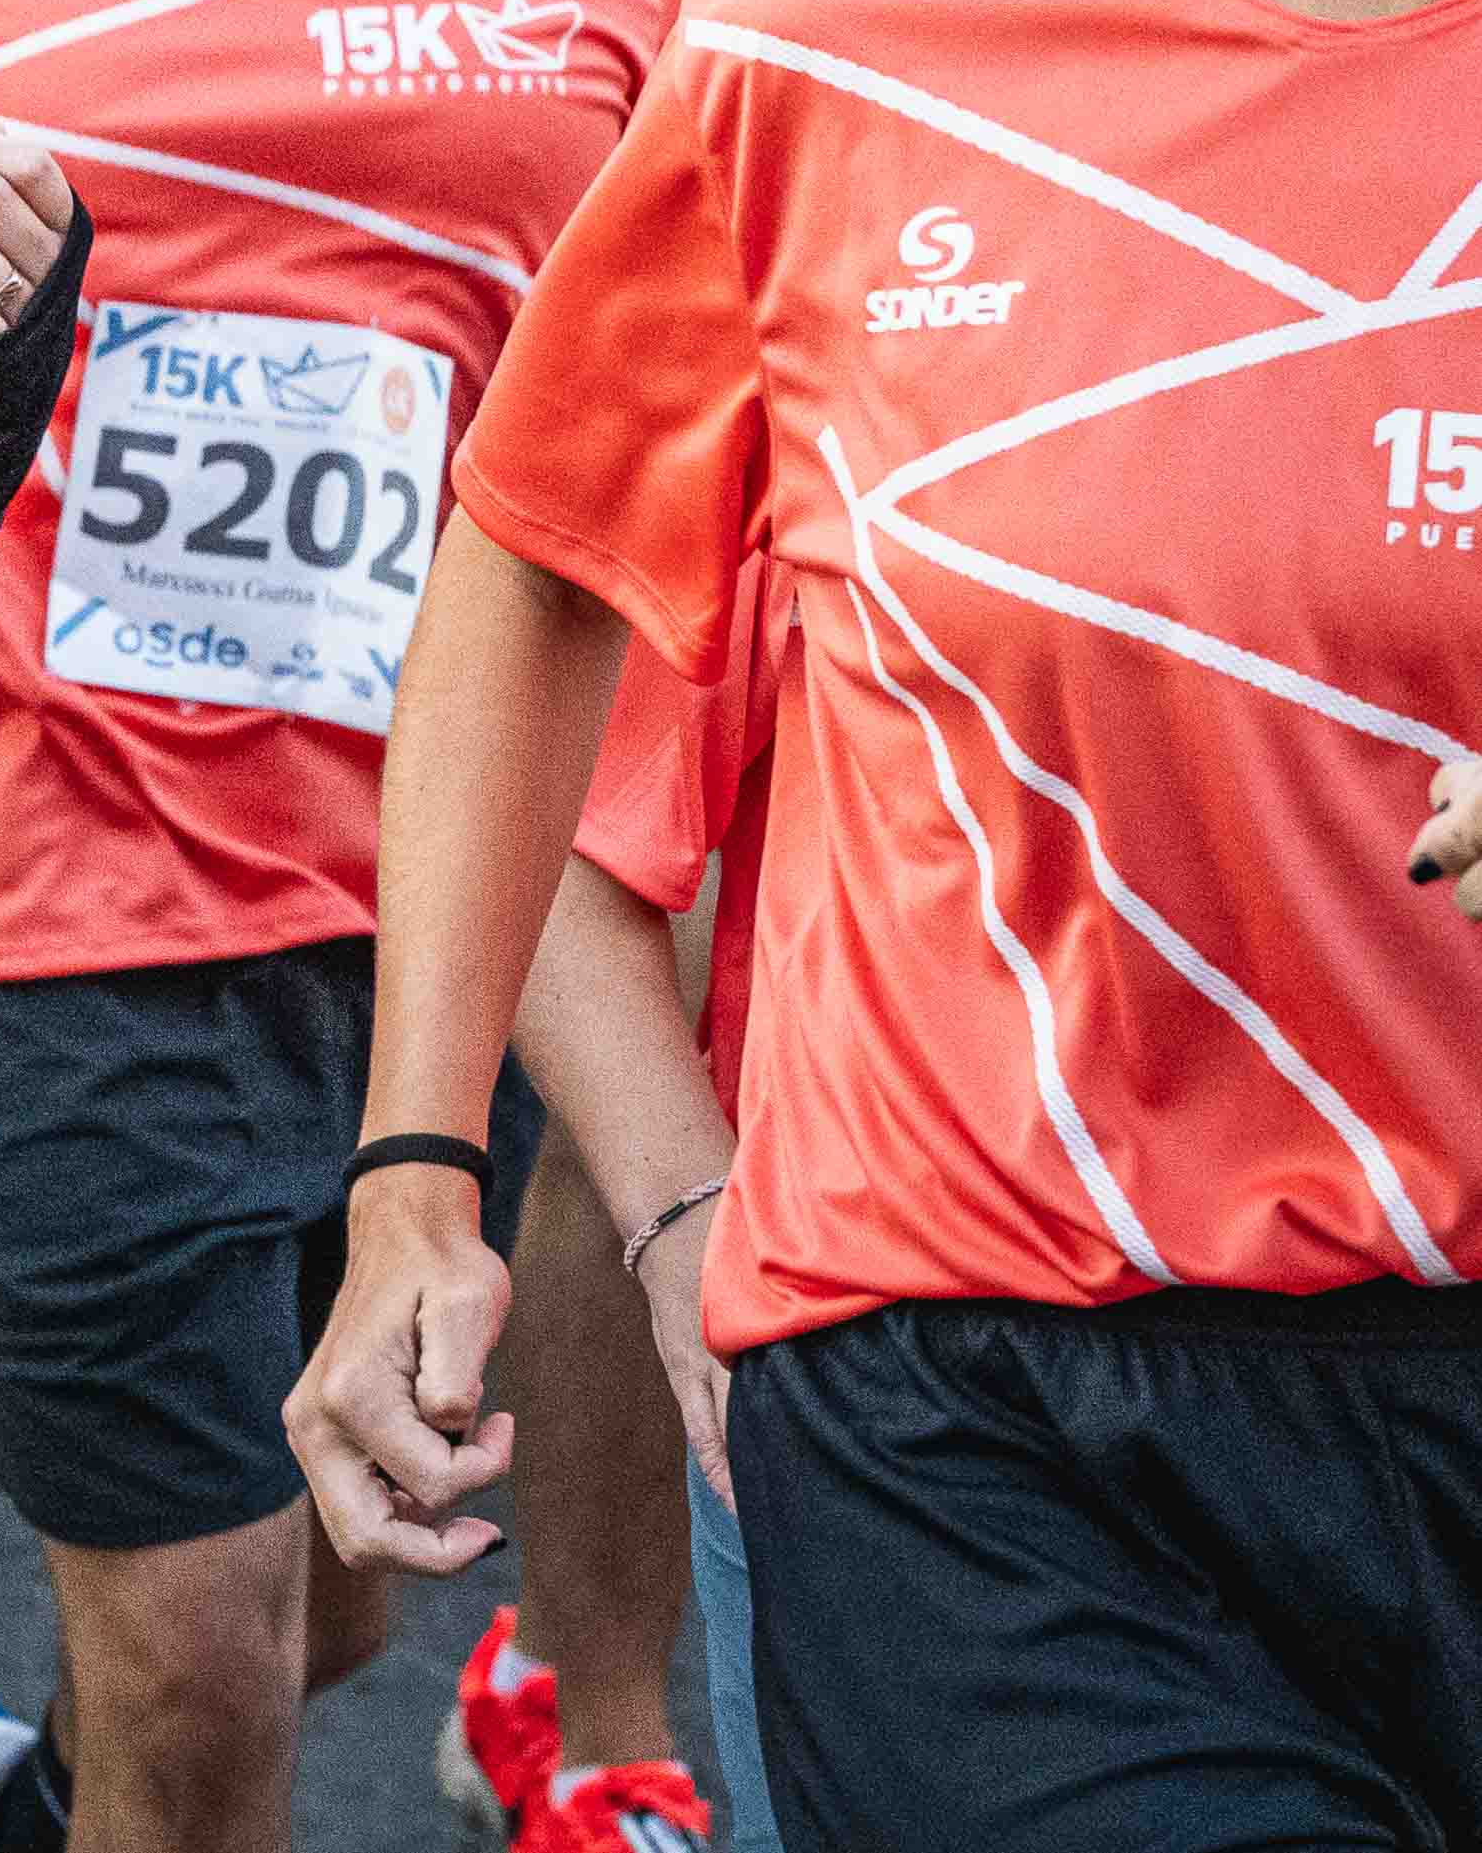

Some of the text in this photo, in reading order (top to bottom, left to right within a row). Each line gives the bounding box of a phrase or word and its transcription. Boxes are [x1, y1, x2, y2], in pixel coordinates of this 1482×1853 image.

[306, 3, 458, 75] 15K
[139, 345, 246, 406] 15K
[79, 424, 421, 595] 5202
[113, 622, 248, 669] osde
